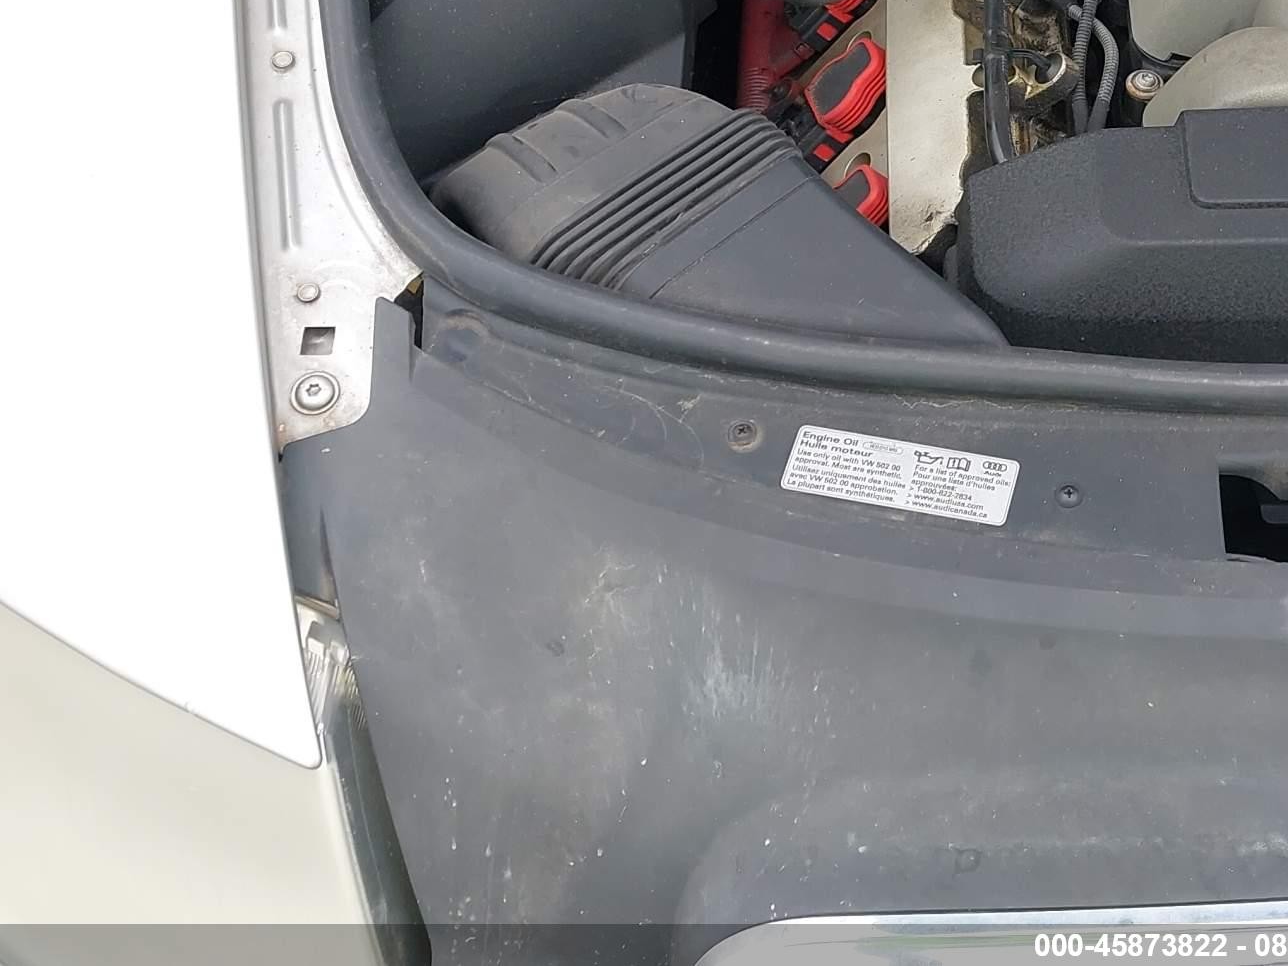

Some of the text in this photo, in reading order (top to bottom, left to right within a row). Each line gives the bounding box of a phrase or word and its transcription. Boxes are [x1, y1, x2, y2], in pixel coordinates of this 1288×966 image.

[802, 431, 859, 446] Engine Oil
[800, 440, 828, 450] Huile
[831, 446, 874, 457] moteur
[798, 448, 812, 456] Use
[813, 452, 830, 460] only
[843, 456, 859, 464] with
[876, 462, 890, 470] 502
[795, 456, 830, 468] approval.
[832, 462, 851, 470] Most
[866, 468, 902, 480] synthetic.
[912, 472, 930, 480] Pour
[790, 472, 807, 480] avec
[810, 474, 824, 482] VW
[824, 476, 838, 484] 502
[850, 482, 898, 496] approbation.
[821, 469, 867, 483] uniquement
[868, 476, 882, 484] des
[958, 474, 994, 484] approved
[786, 478, 797, 486] La
[798, 480, 826, 491] plupart
[826, 486, 844, 494] sont
[912, 501, 988, 518] www.audicanada.ca
[914, 494, 984, 510] www.audiusa.com
